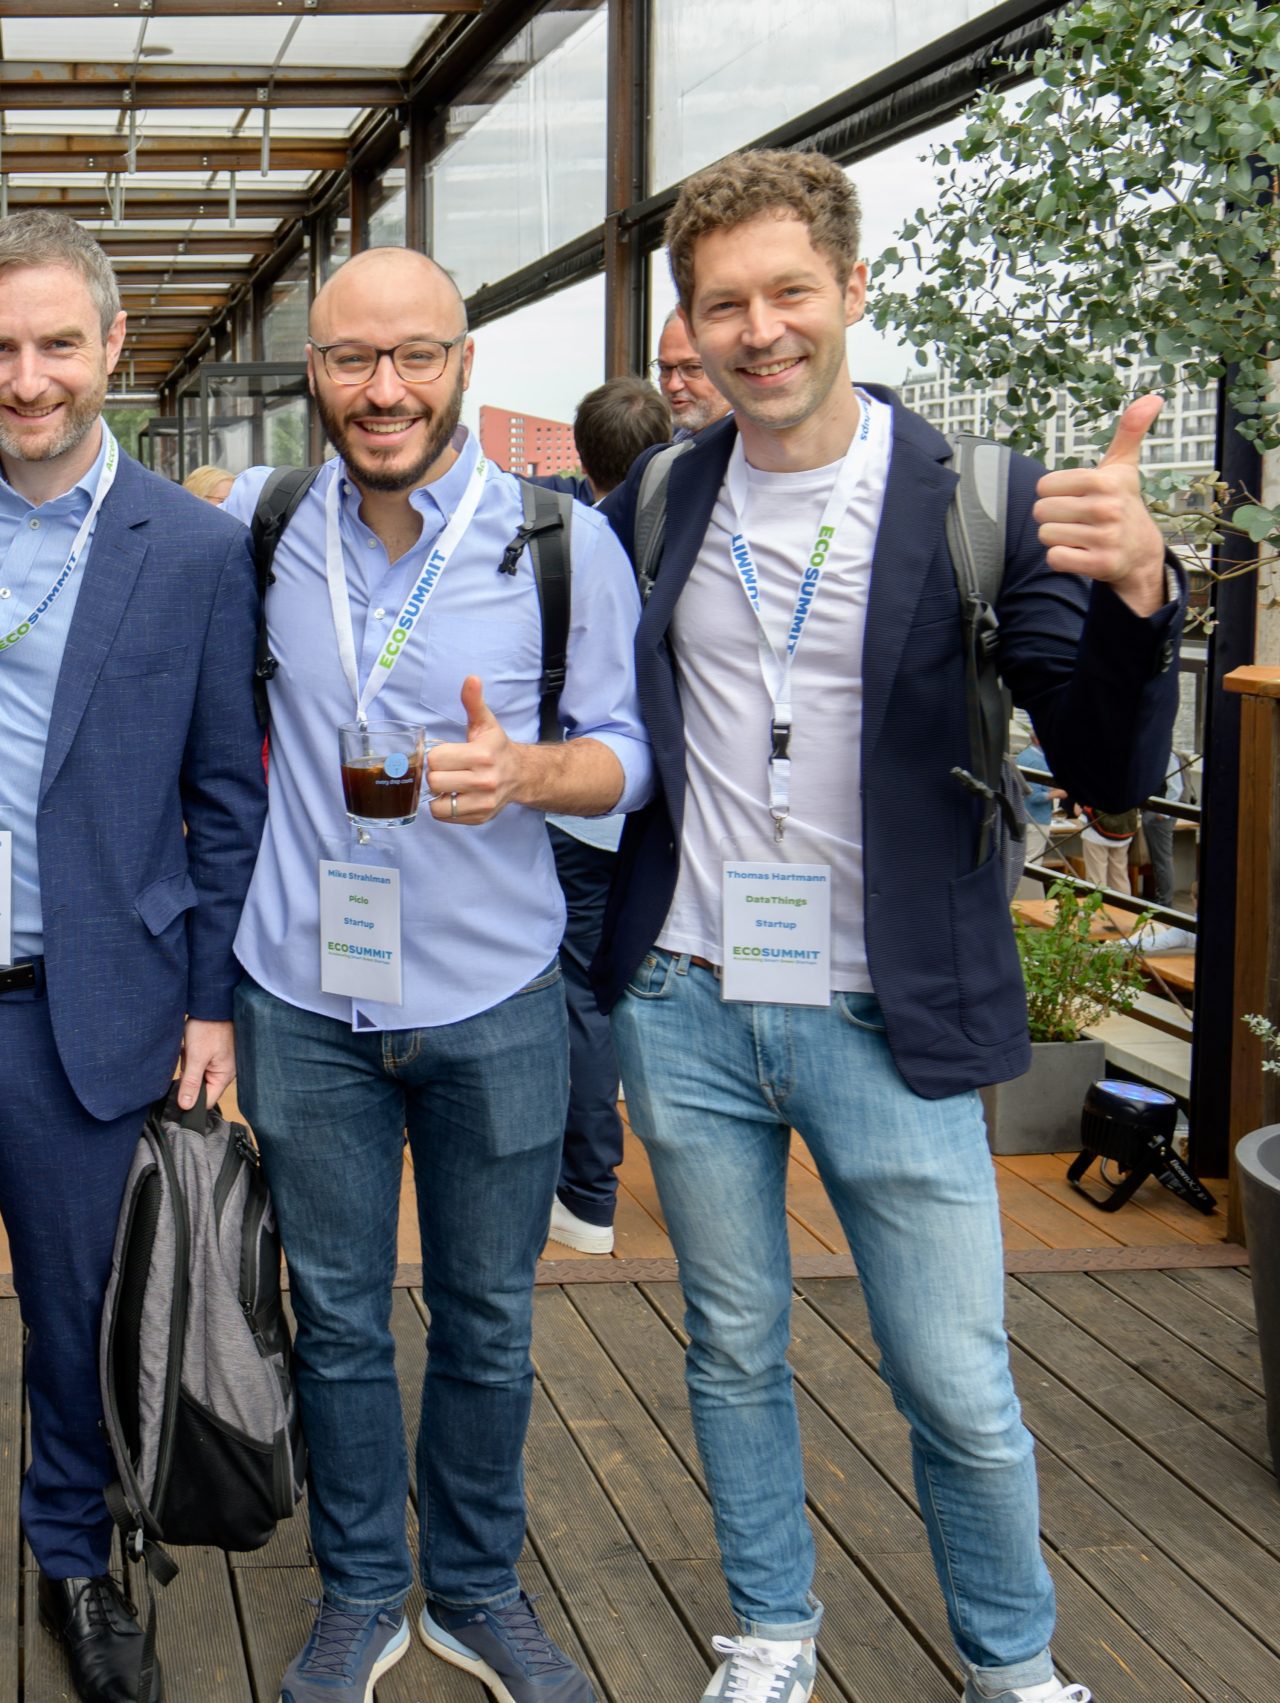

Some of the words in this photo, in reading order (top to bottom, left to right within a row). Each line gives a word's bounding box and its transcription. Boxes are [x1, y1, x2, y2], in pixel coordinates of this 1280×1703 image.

[787, 525, 836, 655] ECOSUMMIT
[379, 549, 446, 670] ECOSUMMIT
[328, 869, 347, 879] Mike
[348, 872, 391, 884] Strahlman
[726, 871, 770, 880] Thomas
[772, 872, 827, 882] Hartmann
[349, 895, 369, 905] Piclo
[745, 895, 808, 907] DataThings
[343, 917, 375, 930] Startup
[755, 919, 797, 931] Startup
[327, 942, 393, 960] ECOSUMMIT
[733, 946, 820, 959] ECOSUMMIT
